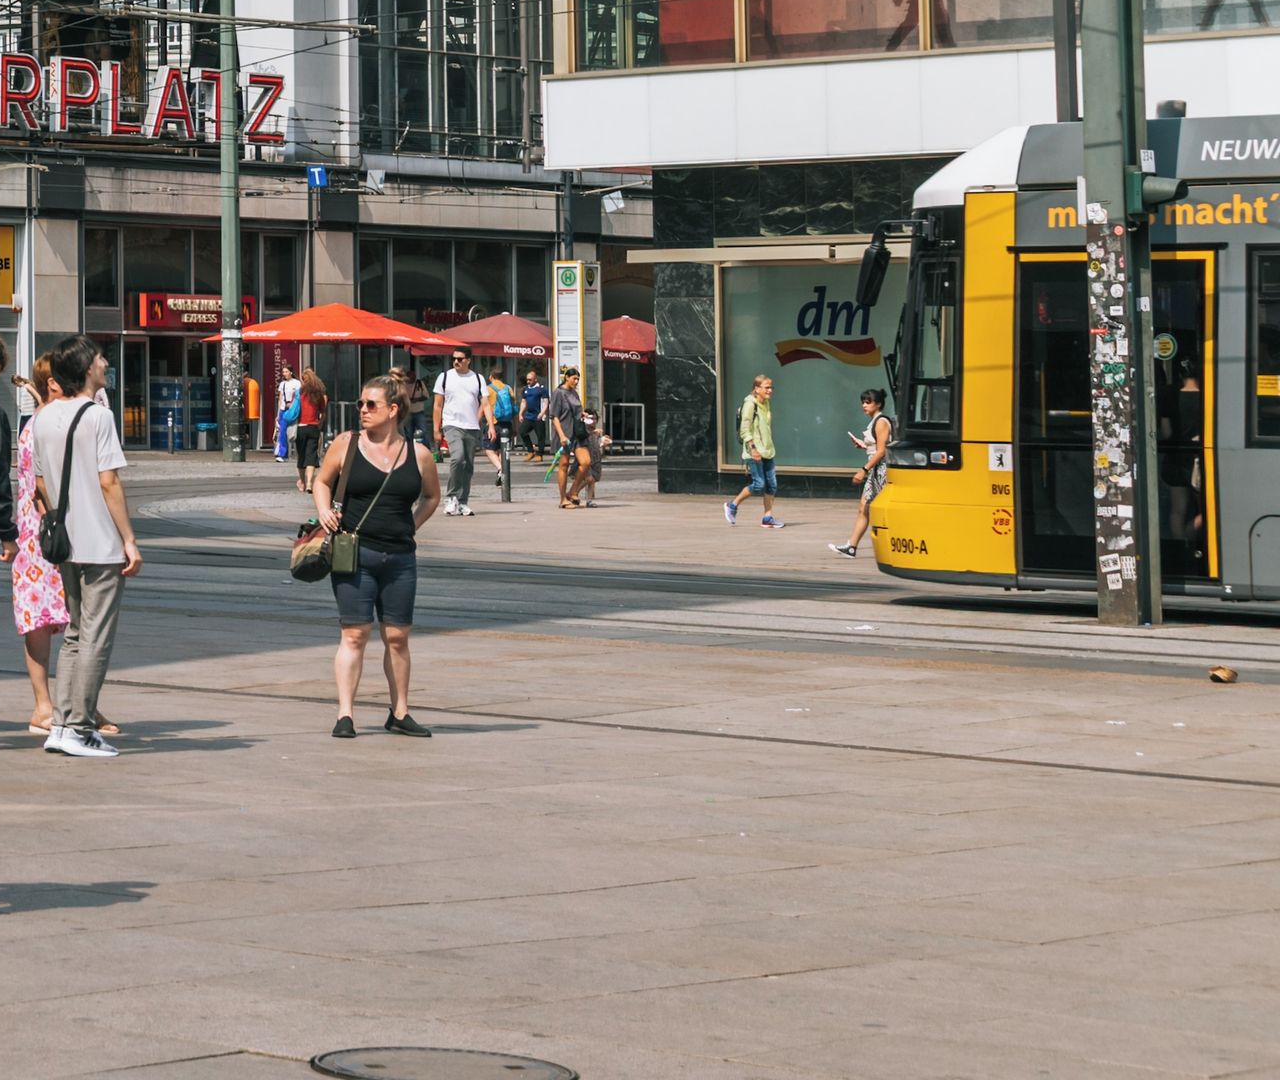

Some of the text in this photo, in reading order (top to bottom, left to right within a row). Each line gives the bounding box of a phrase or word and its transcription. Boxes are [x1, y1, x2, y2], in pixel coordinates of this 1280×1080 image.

[796, 285, 871, 337] dm
[503, 344, 532, 356] Kamps
[603, 348, 629, 360] Kamps
[991, 483, 1011, 496] BVG
[993, 518, 1011, 526] VBB
[890, 536, 929, 555] 9090-A
